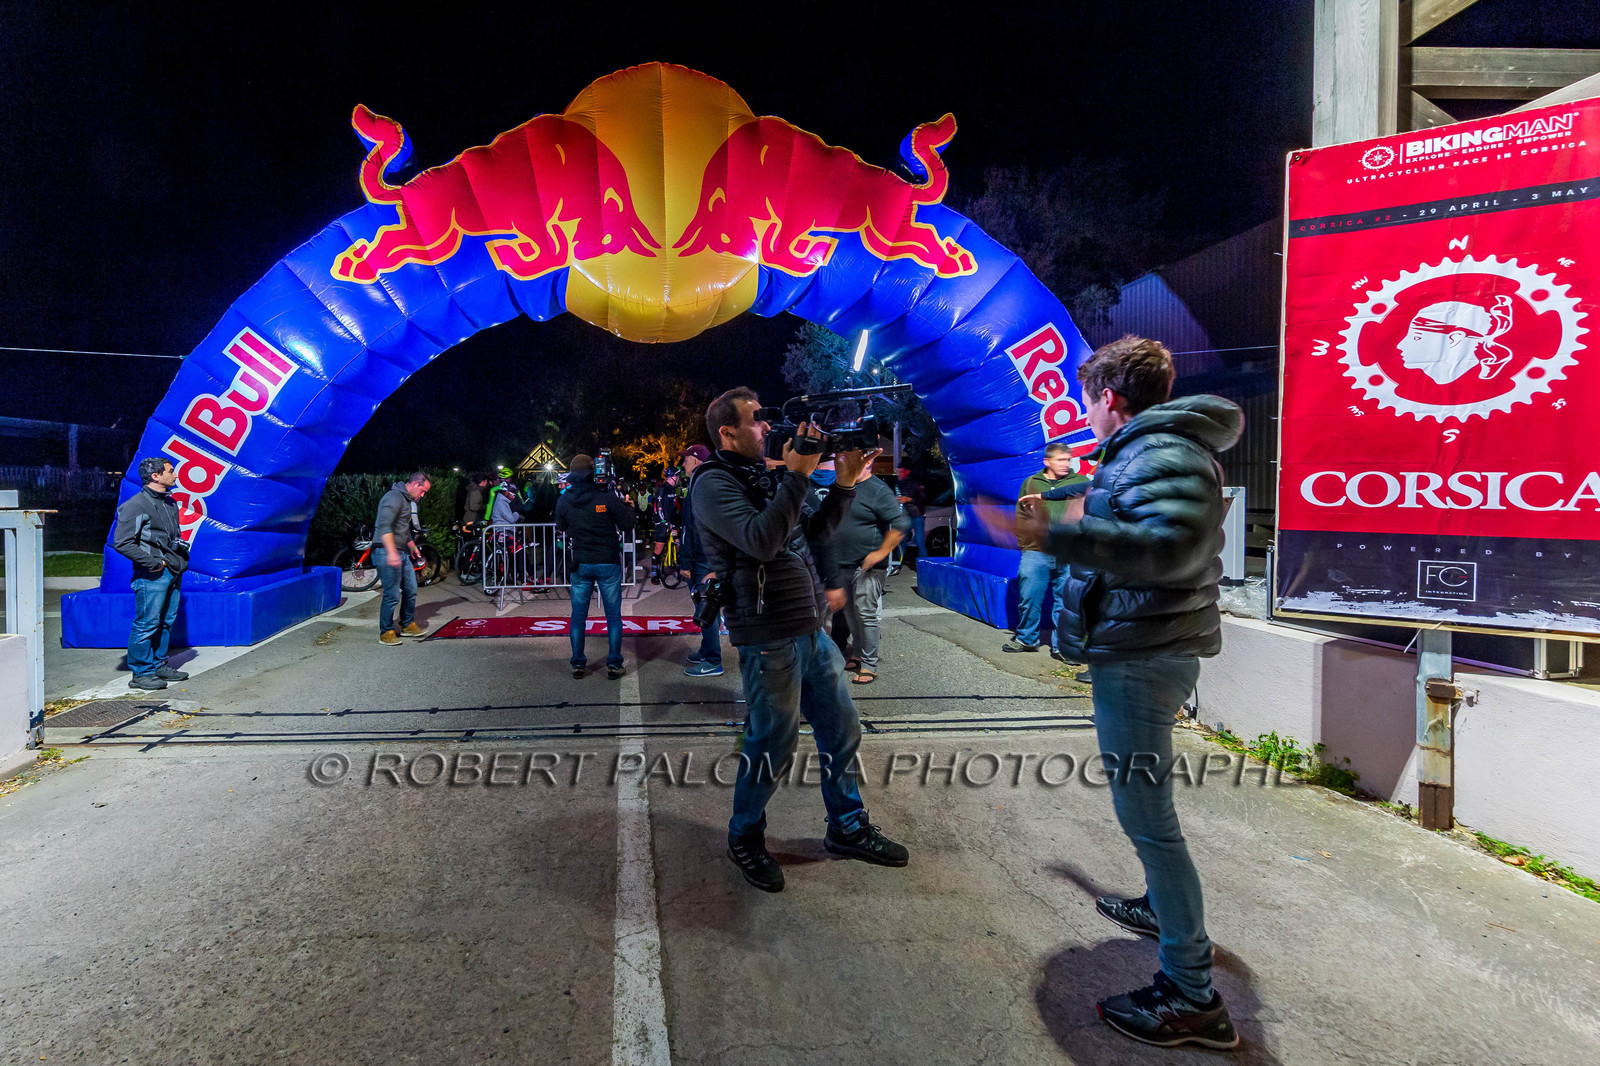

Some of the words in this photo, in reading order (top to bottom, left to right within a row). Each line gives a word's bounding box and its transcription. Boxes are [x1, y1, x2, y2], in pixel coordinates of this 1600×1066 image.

[1405, 113, 1573, 158] BIKINGMAN
[1405, 151, 1451, 164] EXPLORE
[1461, 142, 1504, 155] ENDURE
[1516, 130, 1572, 145] EMPOWER
[1346, 164, 1445, 185] ULTRACYCLING
[1452, 156, 1488, 167] RACE
[1496, 152, 1512, 160] IN
[1520, 140, 1587, 156] CORSICA
[1300, 218, 1363, 232] CORSICA
[1419, 207, 1437, 217] 29
[1448, 199, 1500, 213] APRIL
[1551, 186, 1589, 198] MAY
[1448, 235, 1469, 250] N
[180, 327, 300, 456] Bull
[1005, 323, 1091, 442] Red
[161, 434, 232, 550] ed
[1337, 543, 1492, 556] POWERED
[1535, 551, 1571, 559] BY
[529, 619, 694, 631] STAR
